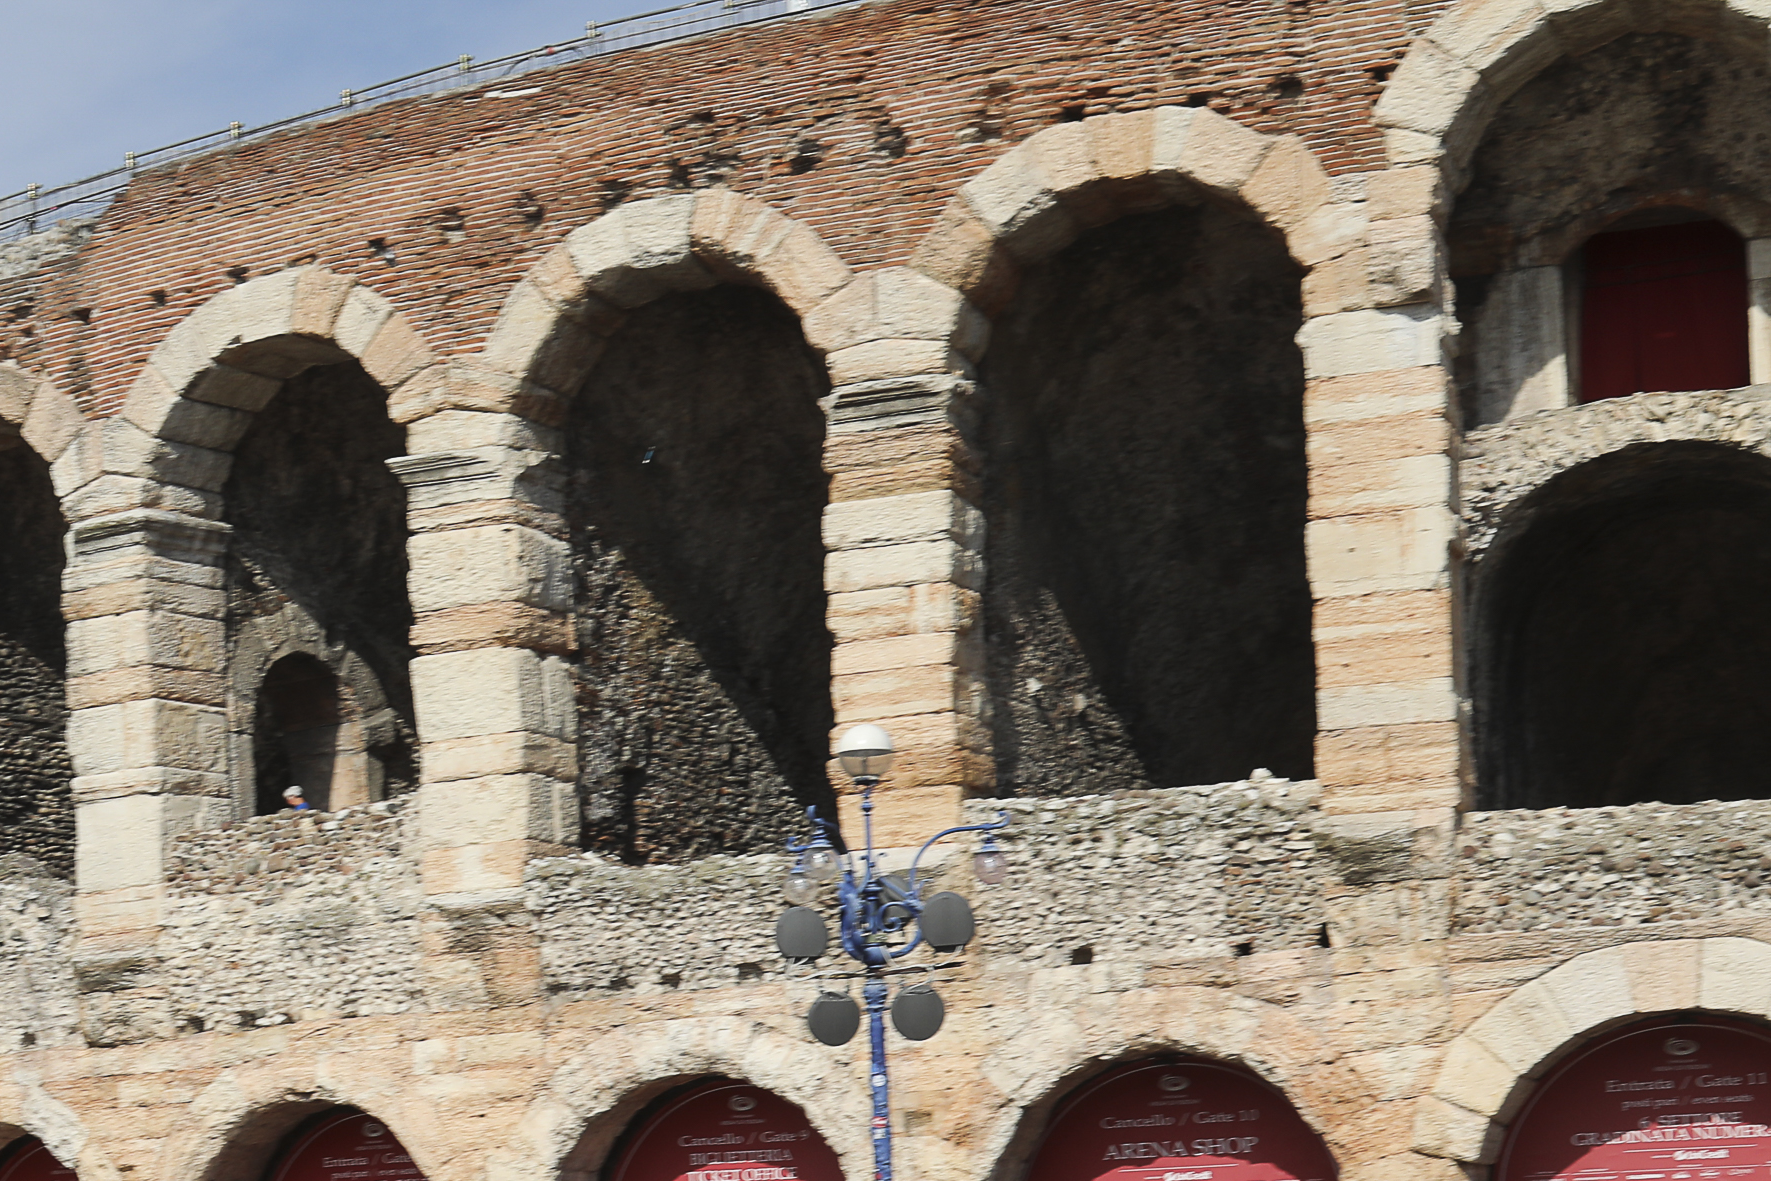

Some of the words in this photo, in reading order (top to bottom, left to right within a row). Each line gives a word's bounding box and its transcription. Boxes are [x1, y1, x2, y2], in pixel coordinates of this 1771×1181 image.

[1604, 1078, 1676, 1093] Entrata
[1695, 1073, 1743, 1088] Gate
[1099, 1113, 1176, 1130] Cancello
[1192, 1110, 1235, 1125] Gate
[678, 1132, 745, 1147] Cancello
[759, 1130, 795, 1144] Gate
[1102, 1139, 1191, 1161] ARENA
[1191, 1135, 1259, 1155] SHOP
[688, 1149, 794, 1166] BIGLIETTERIA
[740, 1166, 799, 1181] OFFICE
